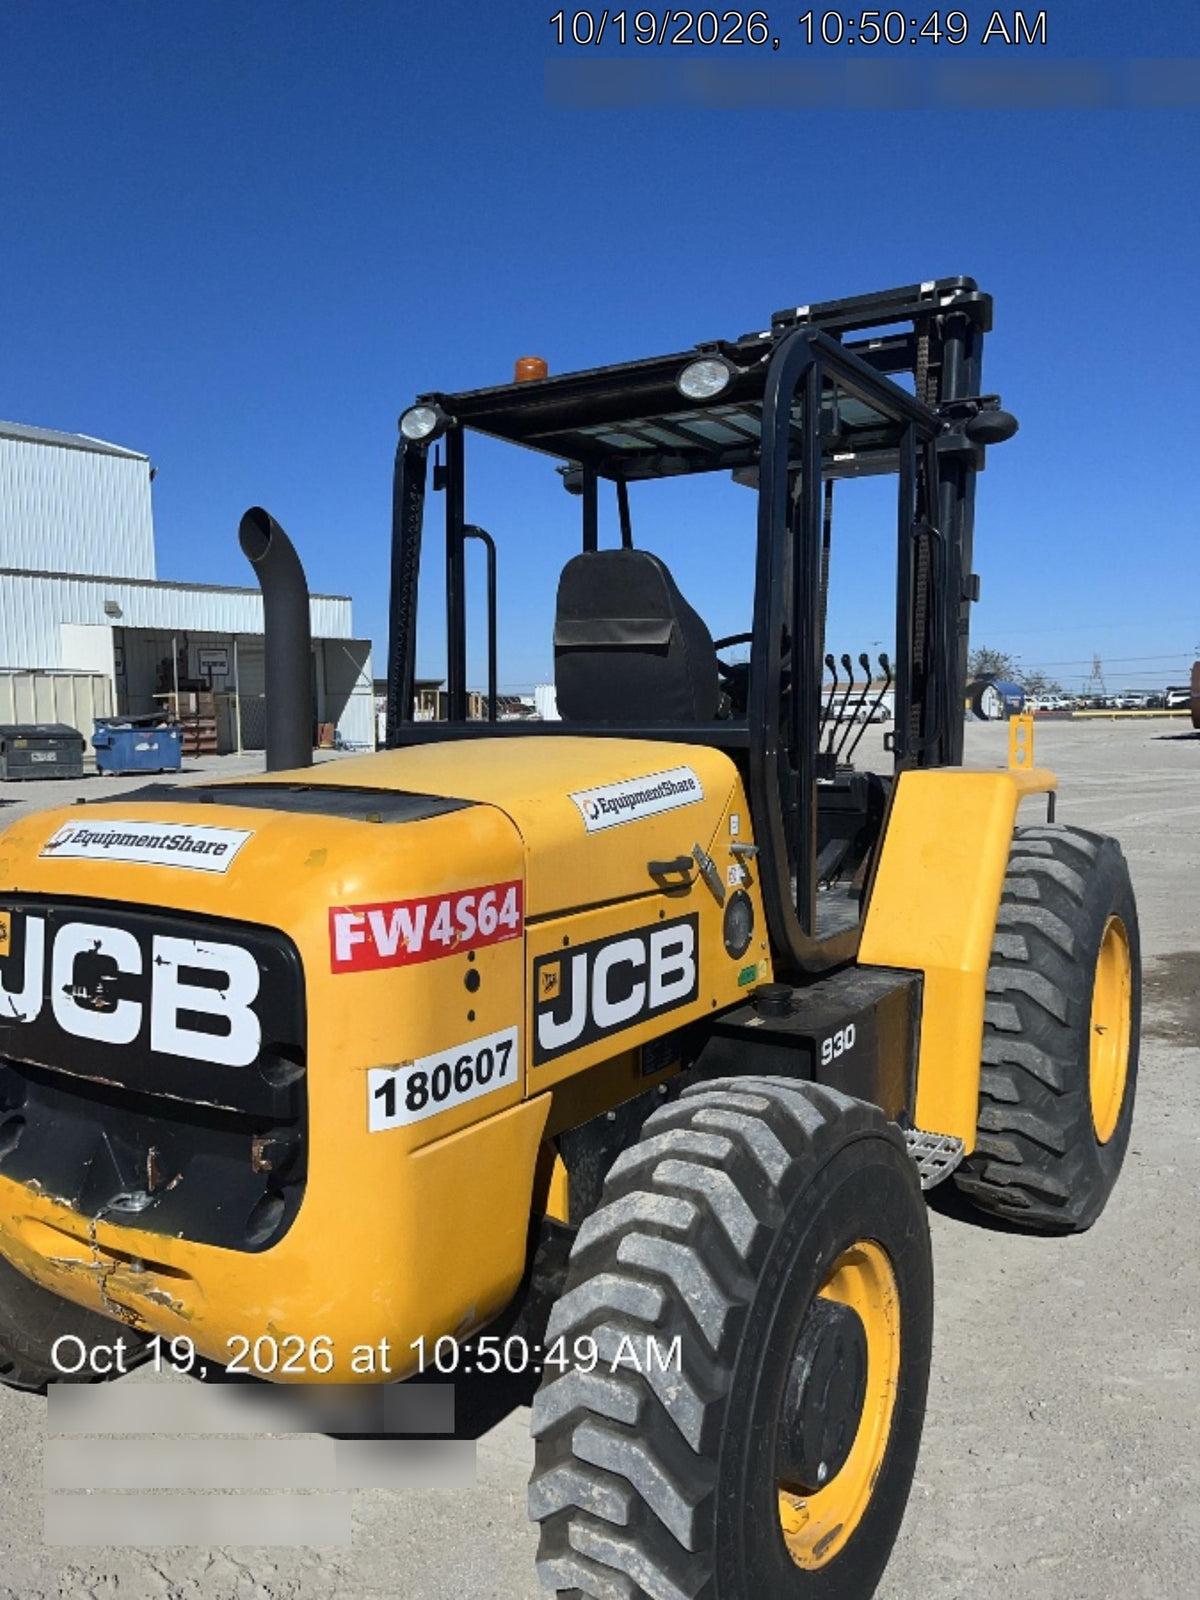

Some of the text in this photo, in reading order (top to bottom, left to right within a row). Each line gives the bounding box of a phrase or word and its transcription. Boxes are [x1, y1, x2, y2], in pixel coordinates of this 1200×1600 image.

[597, 778, 696, 815] EquipmentShare
[70, 829, 229, 856] EquipmentShare
[334, 886, 520, 961] FW4S64
[0, 915, 262, 1067] JCB
[538, 924, 696, 1050] JCB
[374, 1039, 513, 1117] 180607
[821, 1023, 856, 1066] 930
